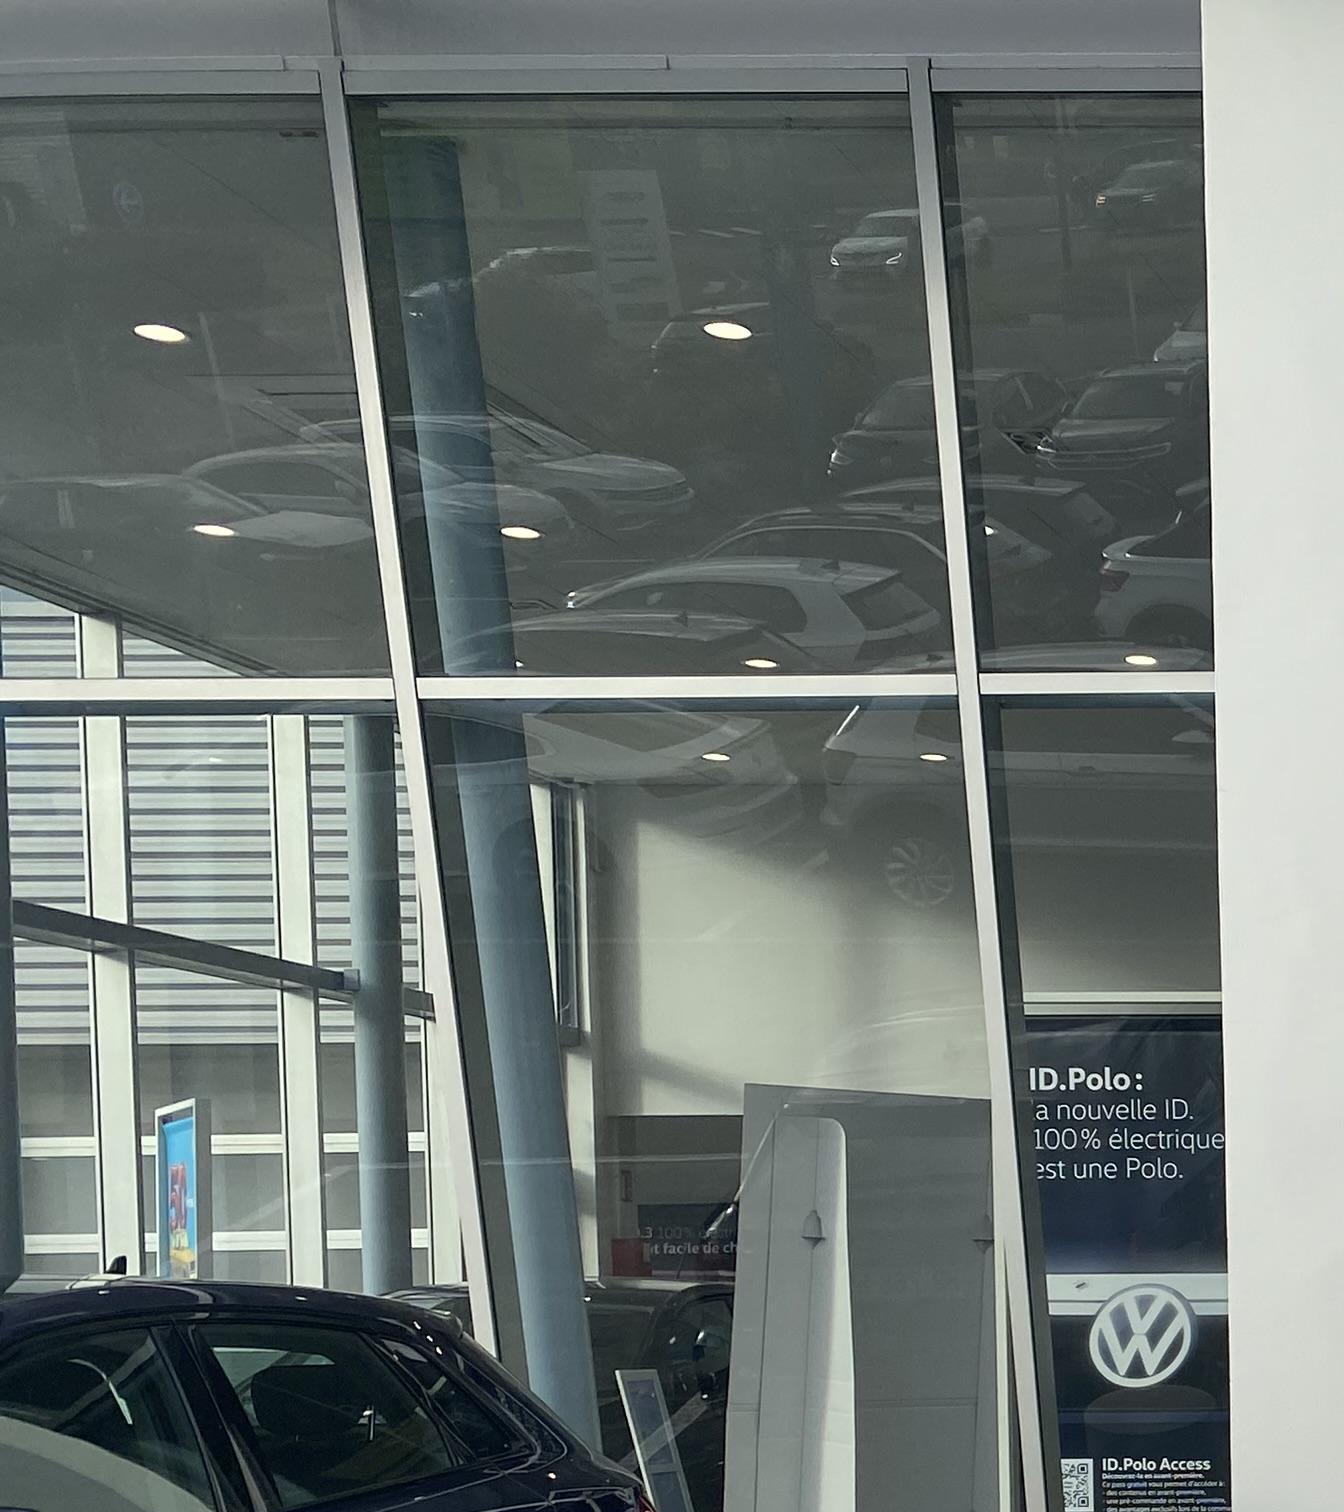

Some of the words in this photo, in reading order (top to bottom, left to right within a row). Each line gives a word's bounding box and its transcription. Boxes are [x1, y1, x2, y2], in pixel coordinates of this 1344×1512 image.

[1033, 1100, 1050, 1120] a
[1057, 1098, 1157, 1120] nouvelle
[1165, 1098, 1194, 1120] ID.
[1109, 1127, 1225, 1155] électrique
[1073, 1162, 1118, 1179] une
[1126, 1157, 1183, 1179] Polo.
[1102, 1457, 1157, 1471] ID.Polo
[1159, 1457, 1211, 1471] Access
